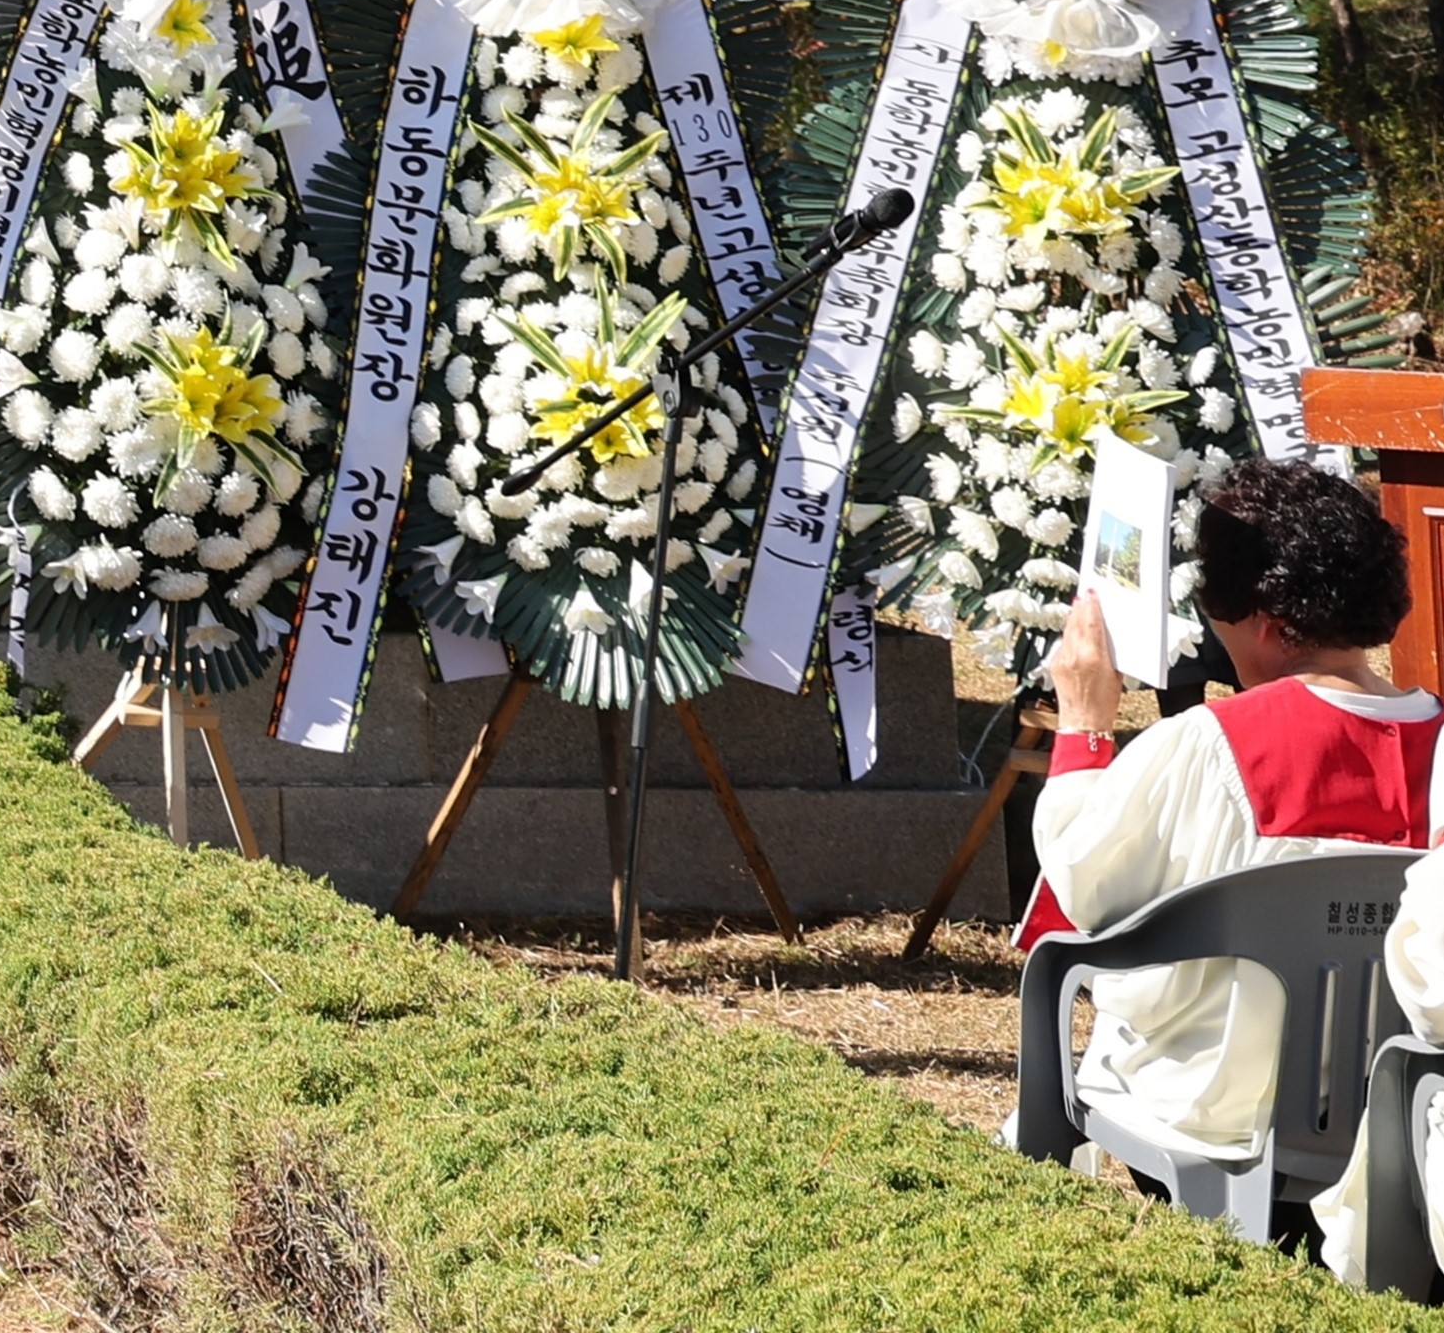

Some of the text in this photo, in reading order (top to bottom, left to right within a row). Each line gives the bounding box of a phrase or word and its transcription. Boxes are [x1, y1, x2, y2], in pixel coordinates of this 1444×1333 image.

[251, 0, 328, 102] 追
[1156, 38, 1228, 109] 추모
[304, 64, 459, 647] 하동문화원장 강태진
[1327, 925, 1388, 936] HP:010-54
